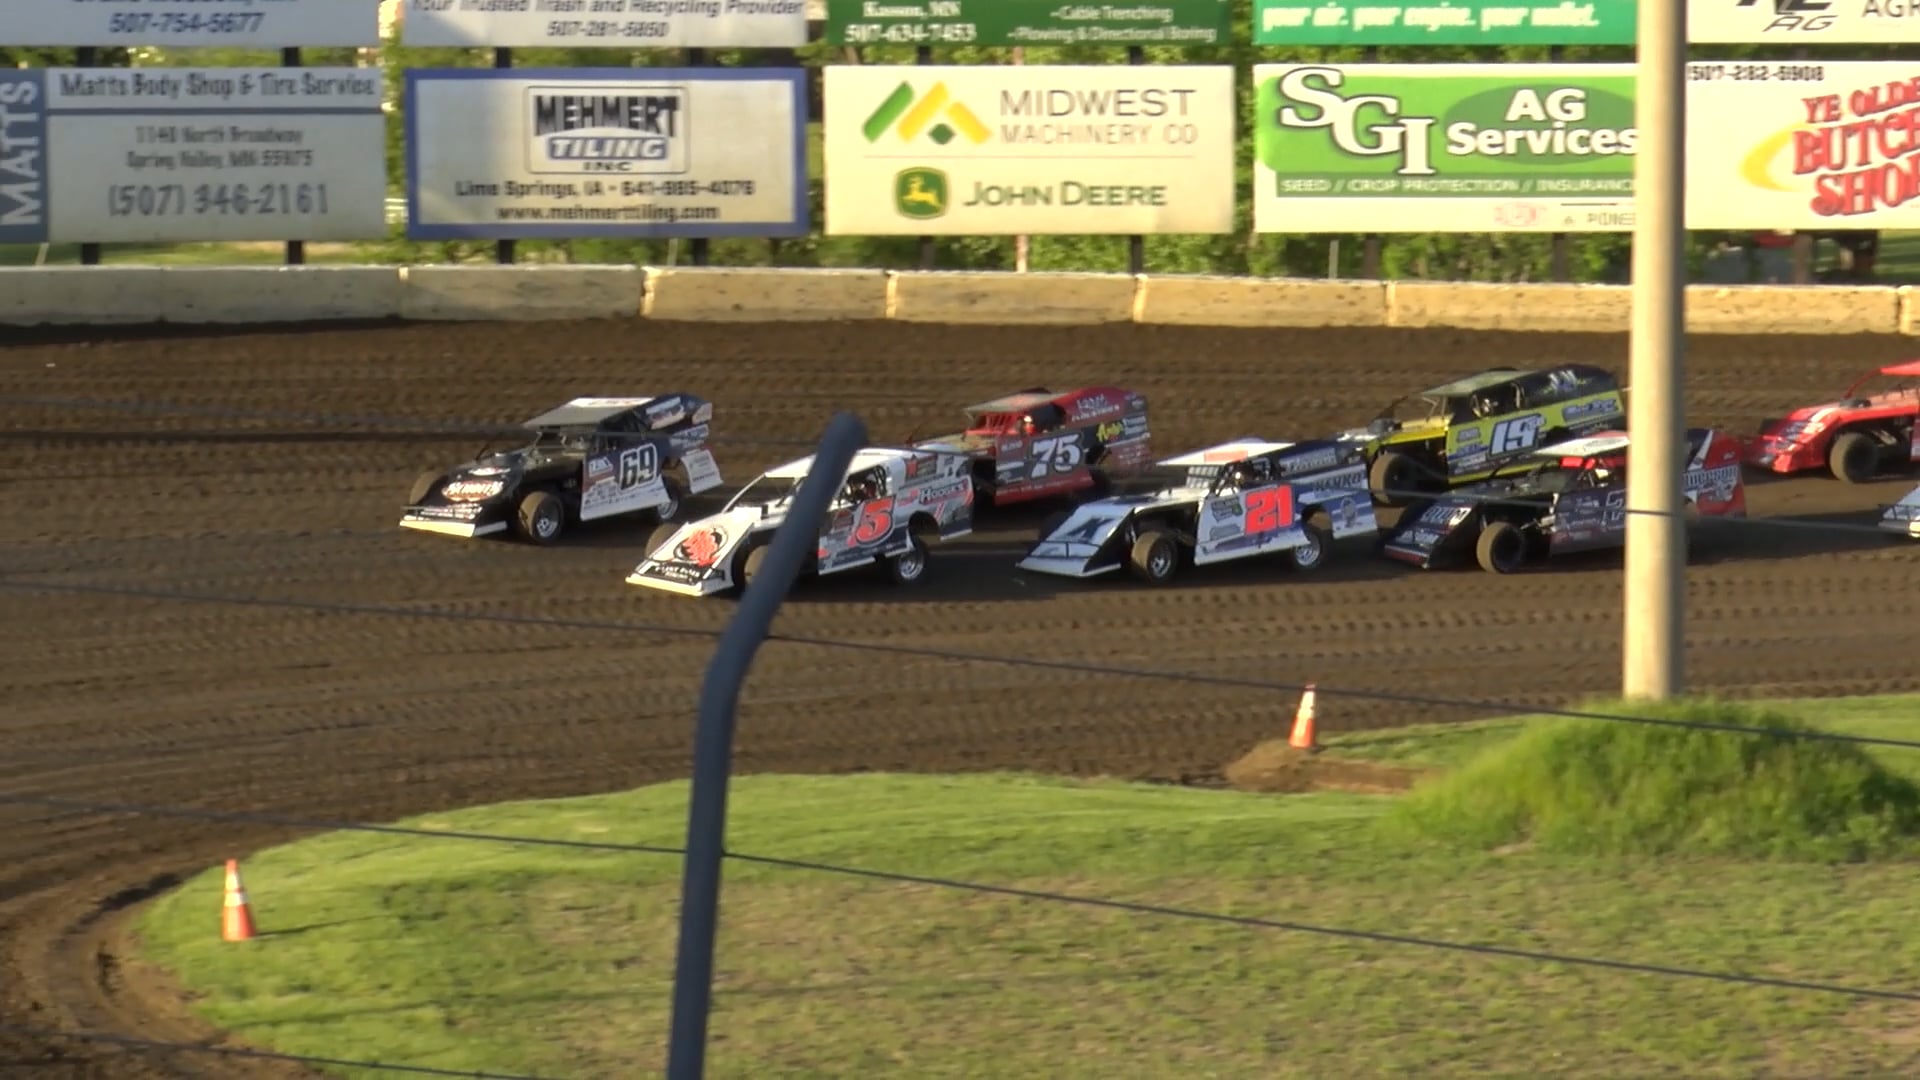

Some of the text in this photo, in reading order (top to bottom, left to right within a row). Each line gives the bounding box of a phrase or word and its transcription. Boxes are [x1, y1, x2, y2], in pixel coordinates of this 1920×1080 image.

[109, 11, 266, 33] 507-754-5677
[628, 0, 720, 17] Recycling
[725, 0, 801, 14] Provider
[1762, 15, 1838, 32] AG
[132, 73, 182, 99] Body
[186, 73, 235, 99] Shop
[259, 73, 297, 95] Tire
[302, 73, 375, 95] Service
[1000, 89, 1196, 116] MIDWEST
[1504, 88, 1587, 122] AG
[1801, 94, 1843, 123] YE
[535, 96, 677, 137] MEHMERT
[1280, 67, 1437, 176] SGI
[1000, 124, 1198, 144] MACHINERY CO
[1446, 121, 1641, 155] Services
[0, 81, 41, 226] MATTS
[551, 138, 666, 158] TILING
[583, 161, 632, 171] INC
[456, 181, 498, 196] Lime
[504, 181, 579, 198] Springs,
[583, 181, 604, 196] IA
[963, 181, 1167, 206] JOHN DEERE
[1281, 180, 1330, 192] SEED
[1347, 180, 1398, 192] CROP
[1403, 180, 1519, 192] PROTECTION
[108, 184, 328, 217] (507) 346-2161
[621, 443, 657, 491] 69
[1032, 434, 1081, 478] 75
[1245, 483, 1294, 535] 21
